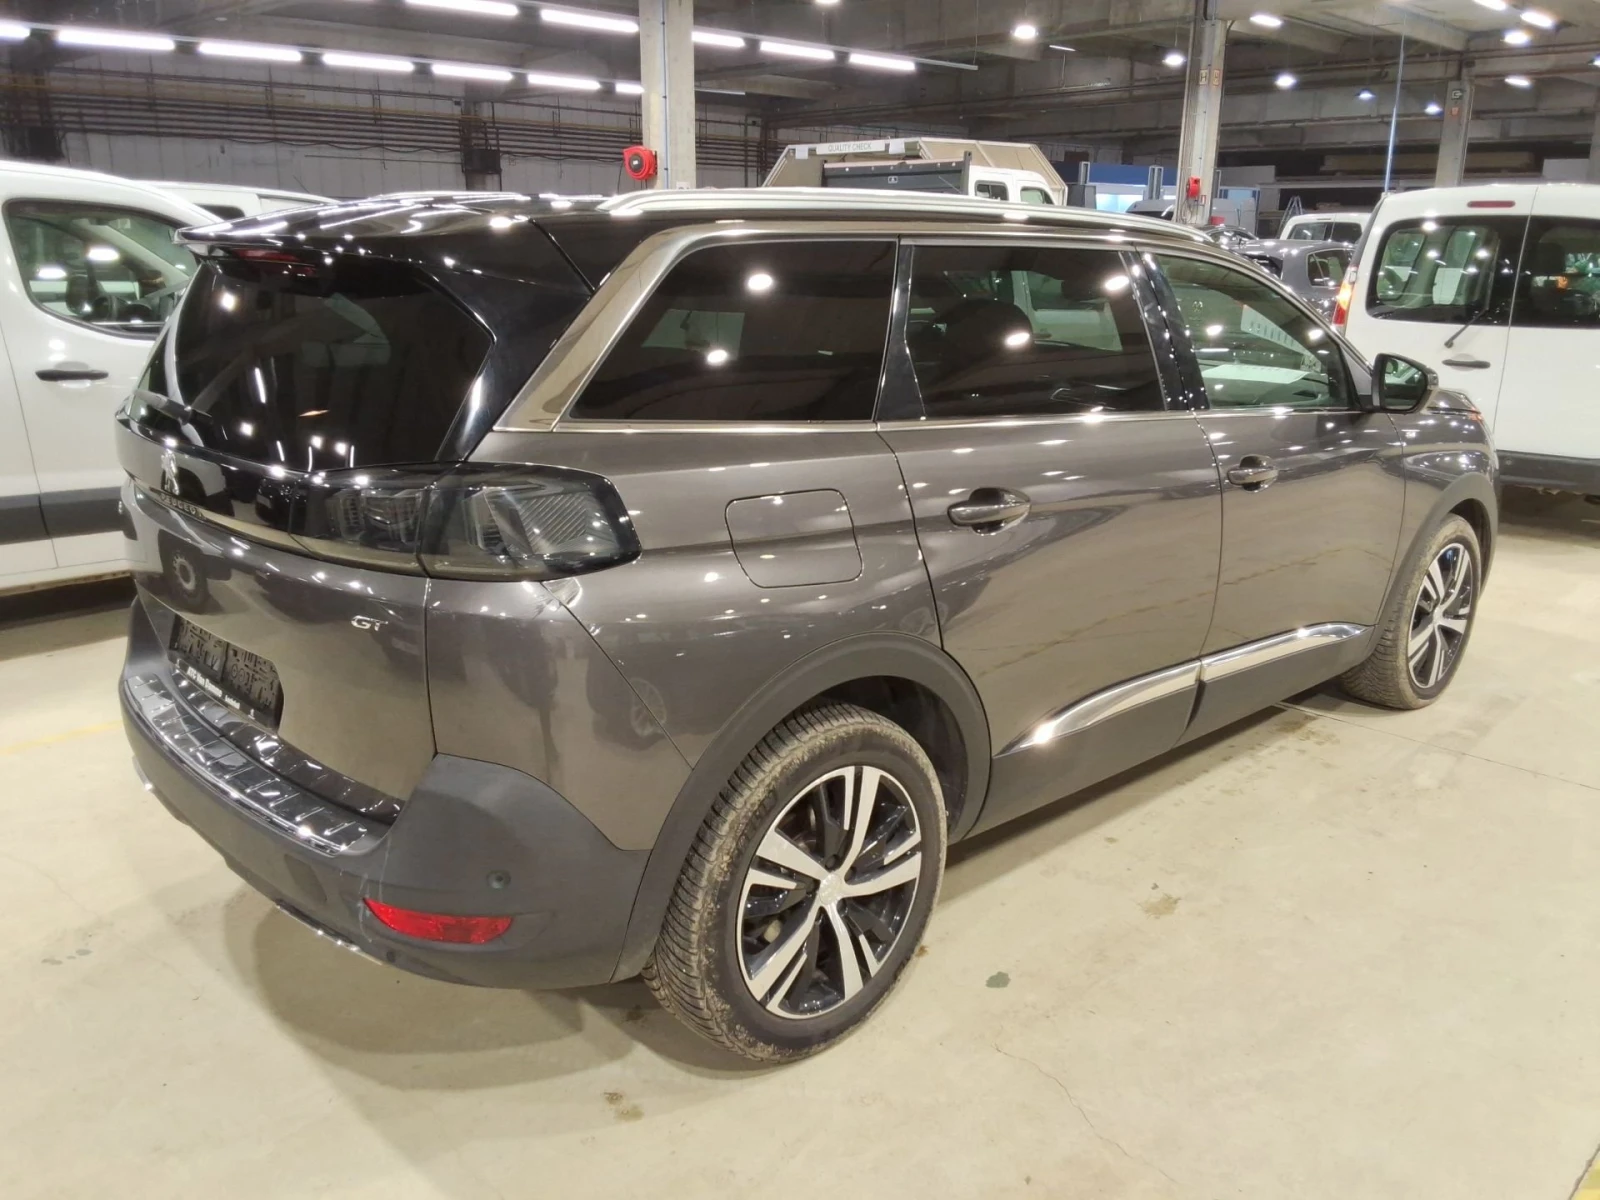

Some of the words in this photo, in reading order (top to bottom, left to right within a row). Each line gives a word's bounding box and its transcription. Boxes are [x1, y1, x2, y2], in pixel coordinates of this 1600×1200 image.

[828, 143, 851, 153] QUALITY
[852, 142, 872, 152] CHECK
[350, 615, 389, 632] GT
